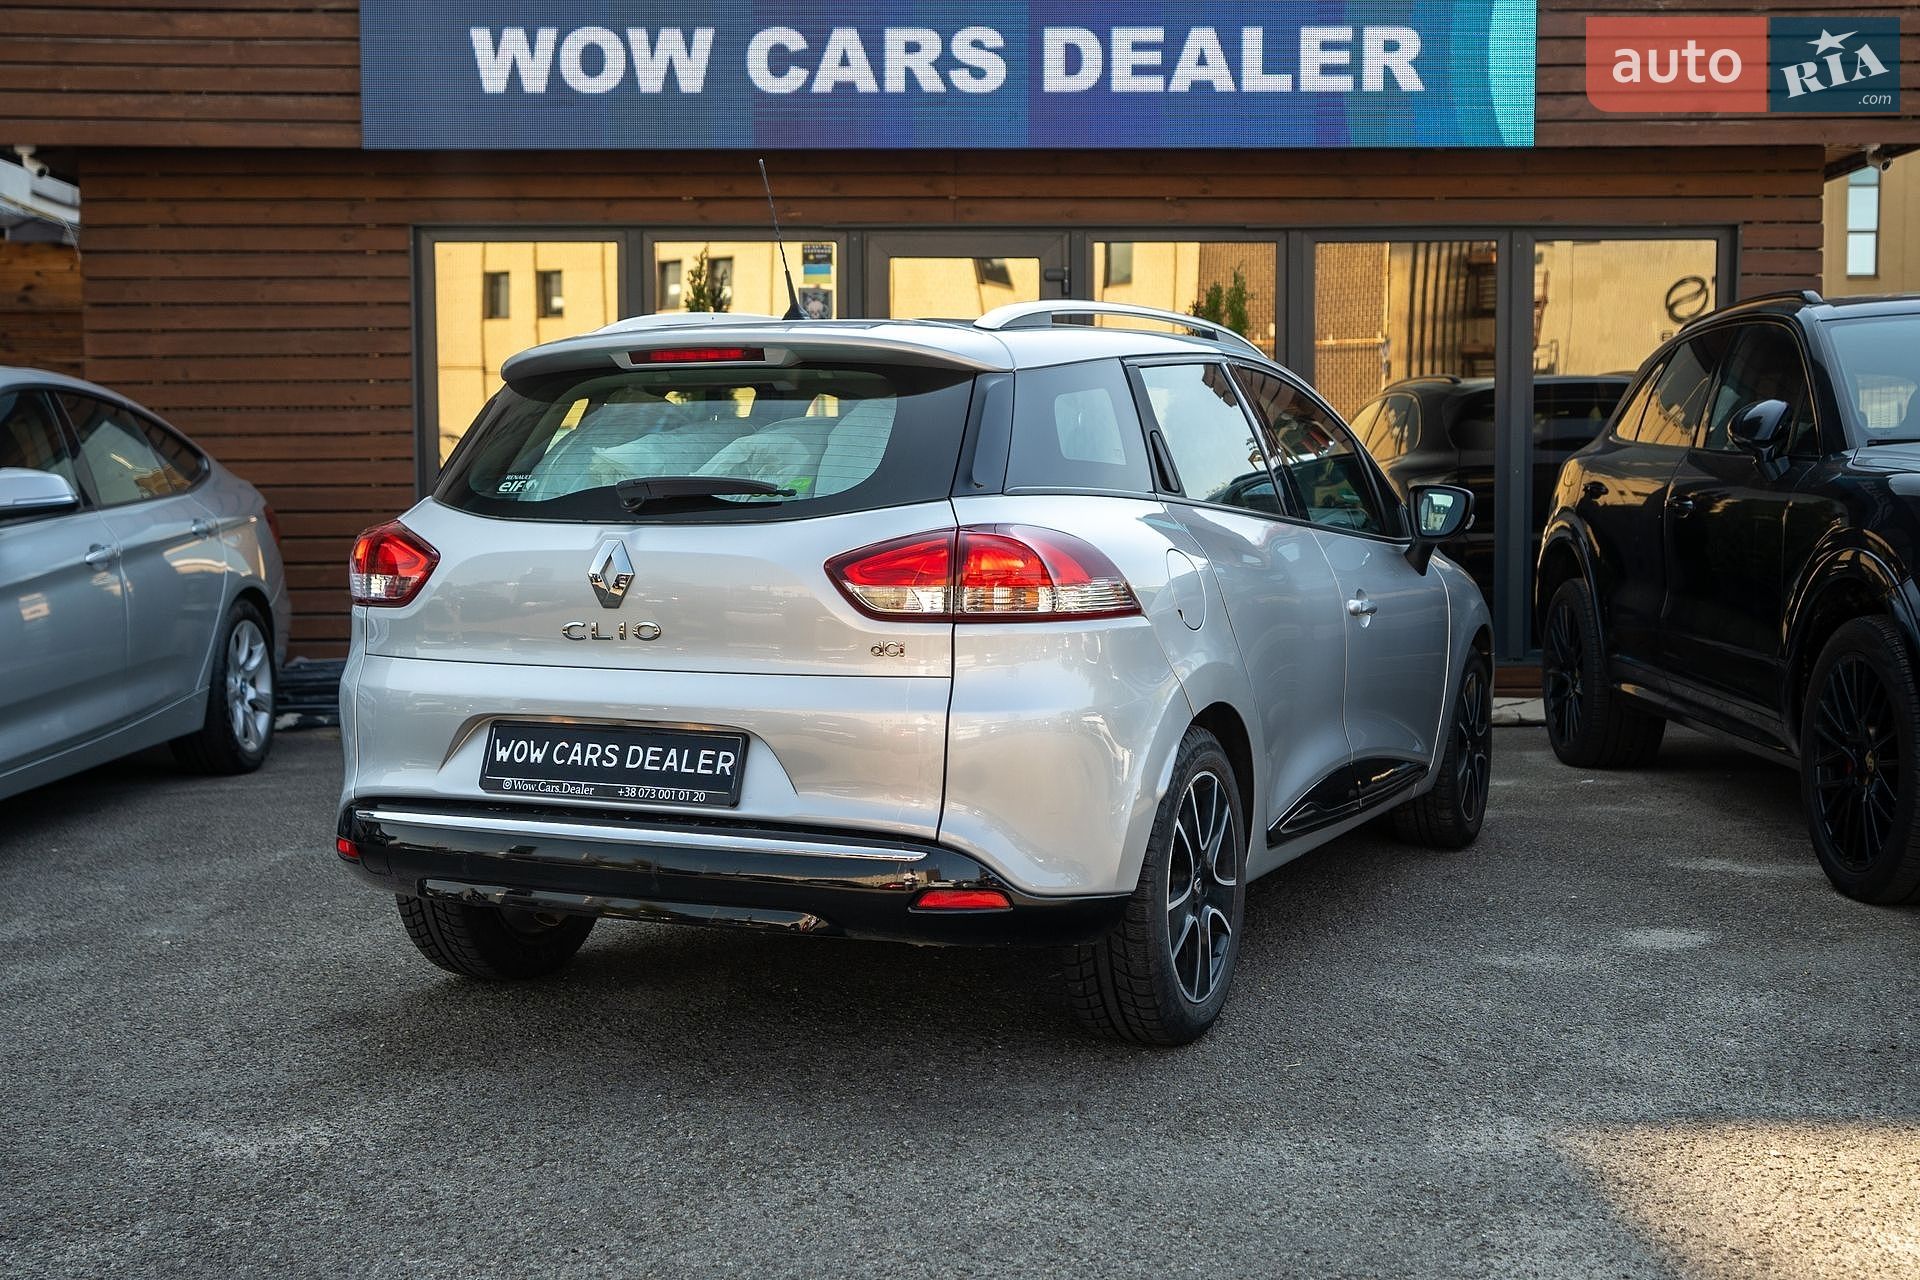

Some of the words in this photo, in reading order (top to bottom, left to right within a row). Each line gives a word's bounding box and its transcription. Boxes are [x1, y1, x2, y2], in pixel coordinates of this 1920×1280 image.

[470, 26, 715, 94] WOW
[746, 26, 1006, 94] CARS
[1043, 25, 1425, 93] DEALER
[561, 621, 662, 641] CLIO
[870, 640, 906, 658] dCi
[495, 738, 550, 764] WOW
[552, 741, 620, 768] CARS
[625, 745, 736, 776] DEALER
[618, 787, 637, 797] +38
[638, 788, 656, 798] 073
[658, 789, 676, 800] 001
[678, 790, 690, 801] 01
[692, 792, 706, 802] 20
